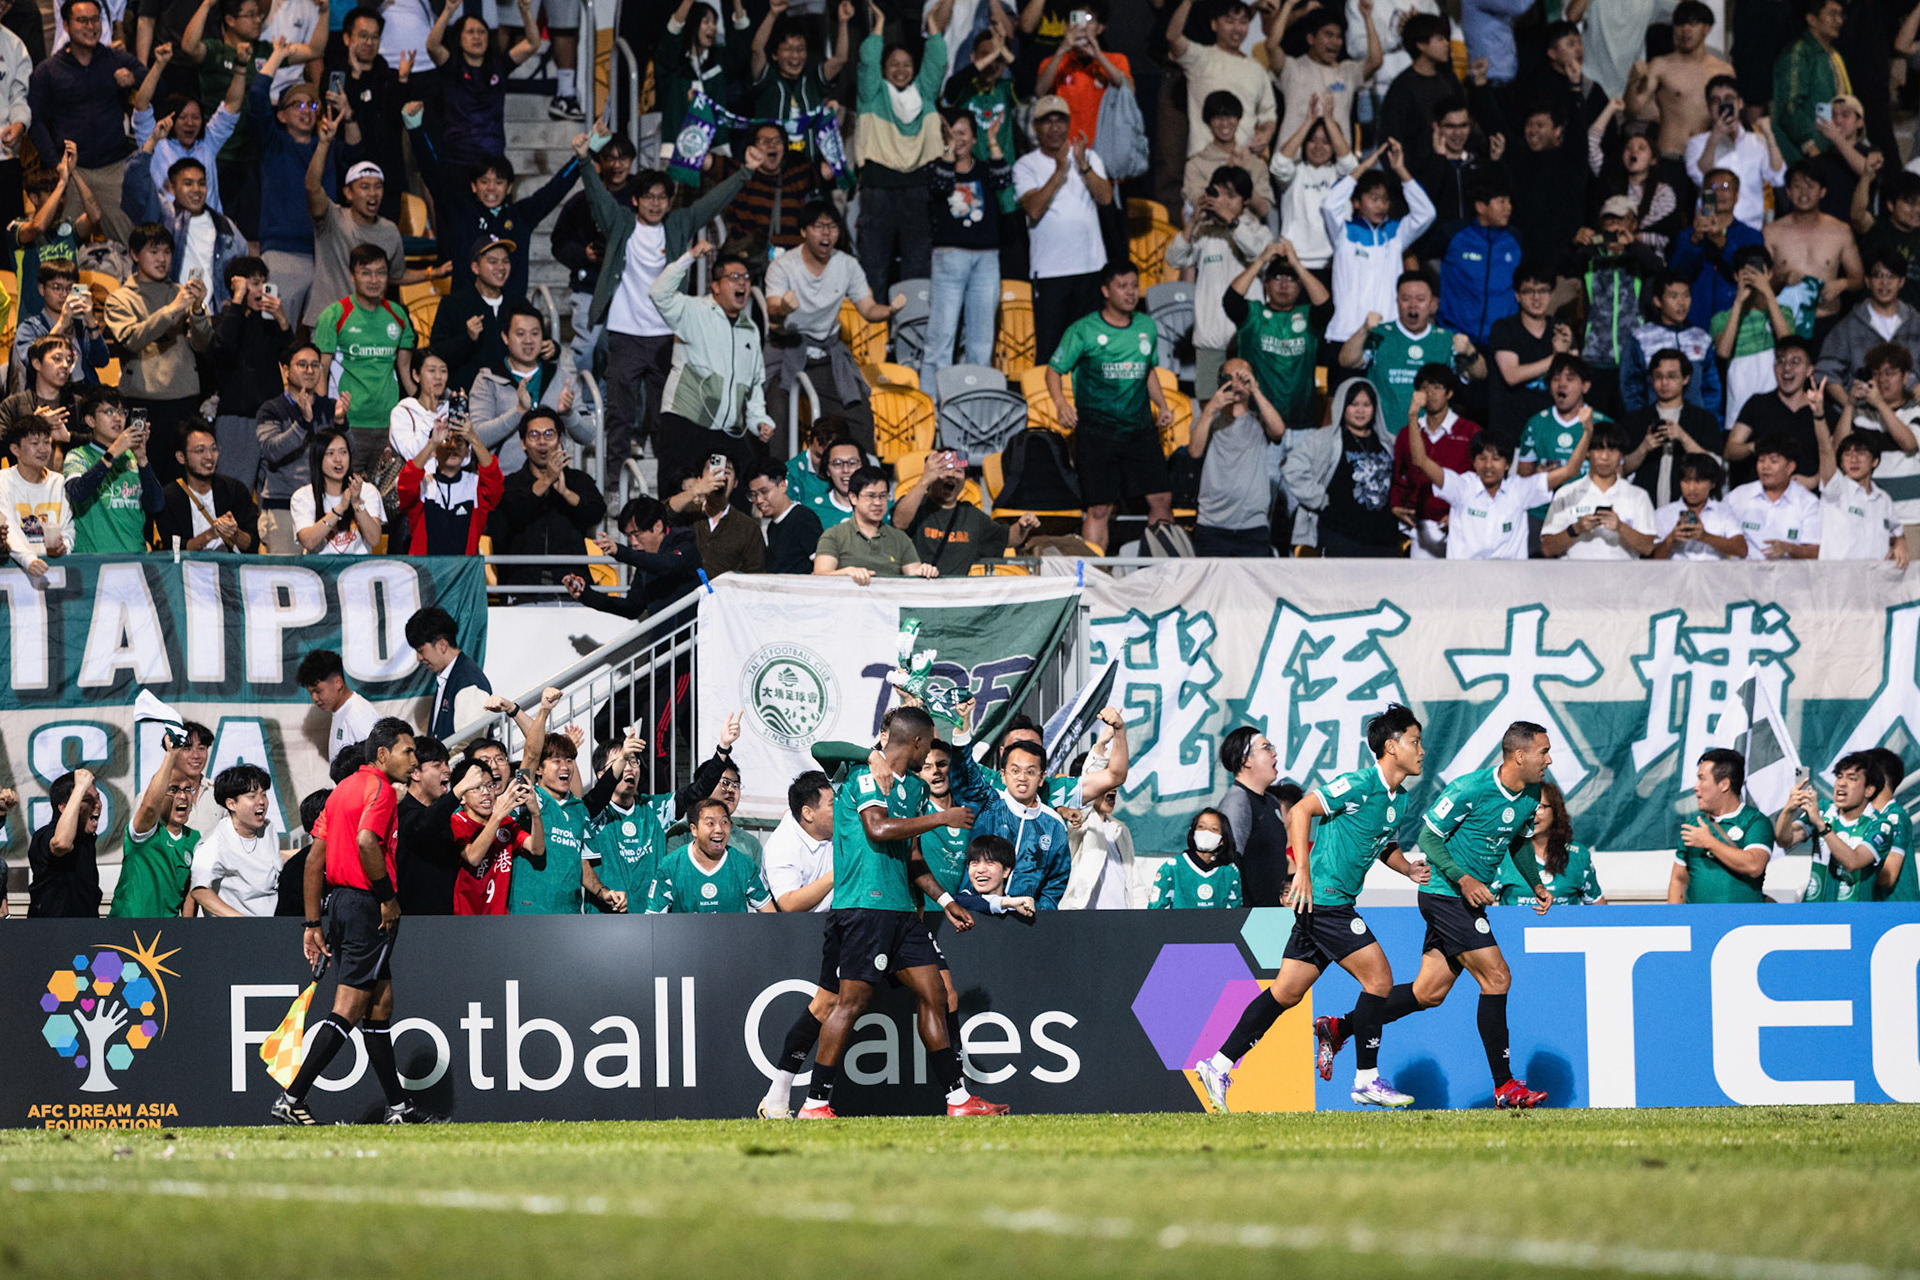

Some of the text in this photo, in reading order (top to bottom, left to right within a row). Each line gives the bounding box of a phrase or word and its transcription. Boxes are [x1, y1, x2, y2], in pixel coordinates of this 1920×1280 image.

[0, 560, 422, 690] TAIPO
[748, 663, 760, 675] TAI
[769, 647, 811, 663] FOOTBALL
[814, 661, 831, 682] CLUB
[763, 729, 816, 747] SINCE 2002
[485, 879, 495, 903] 9
[230, 976, 696, 1092] Football
[27, 1103, 179, 1118] AFC DREAM ASIA
[45, 1118, 162, 1130] FOUNDATION
